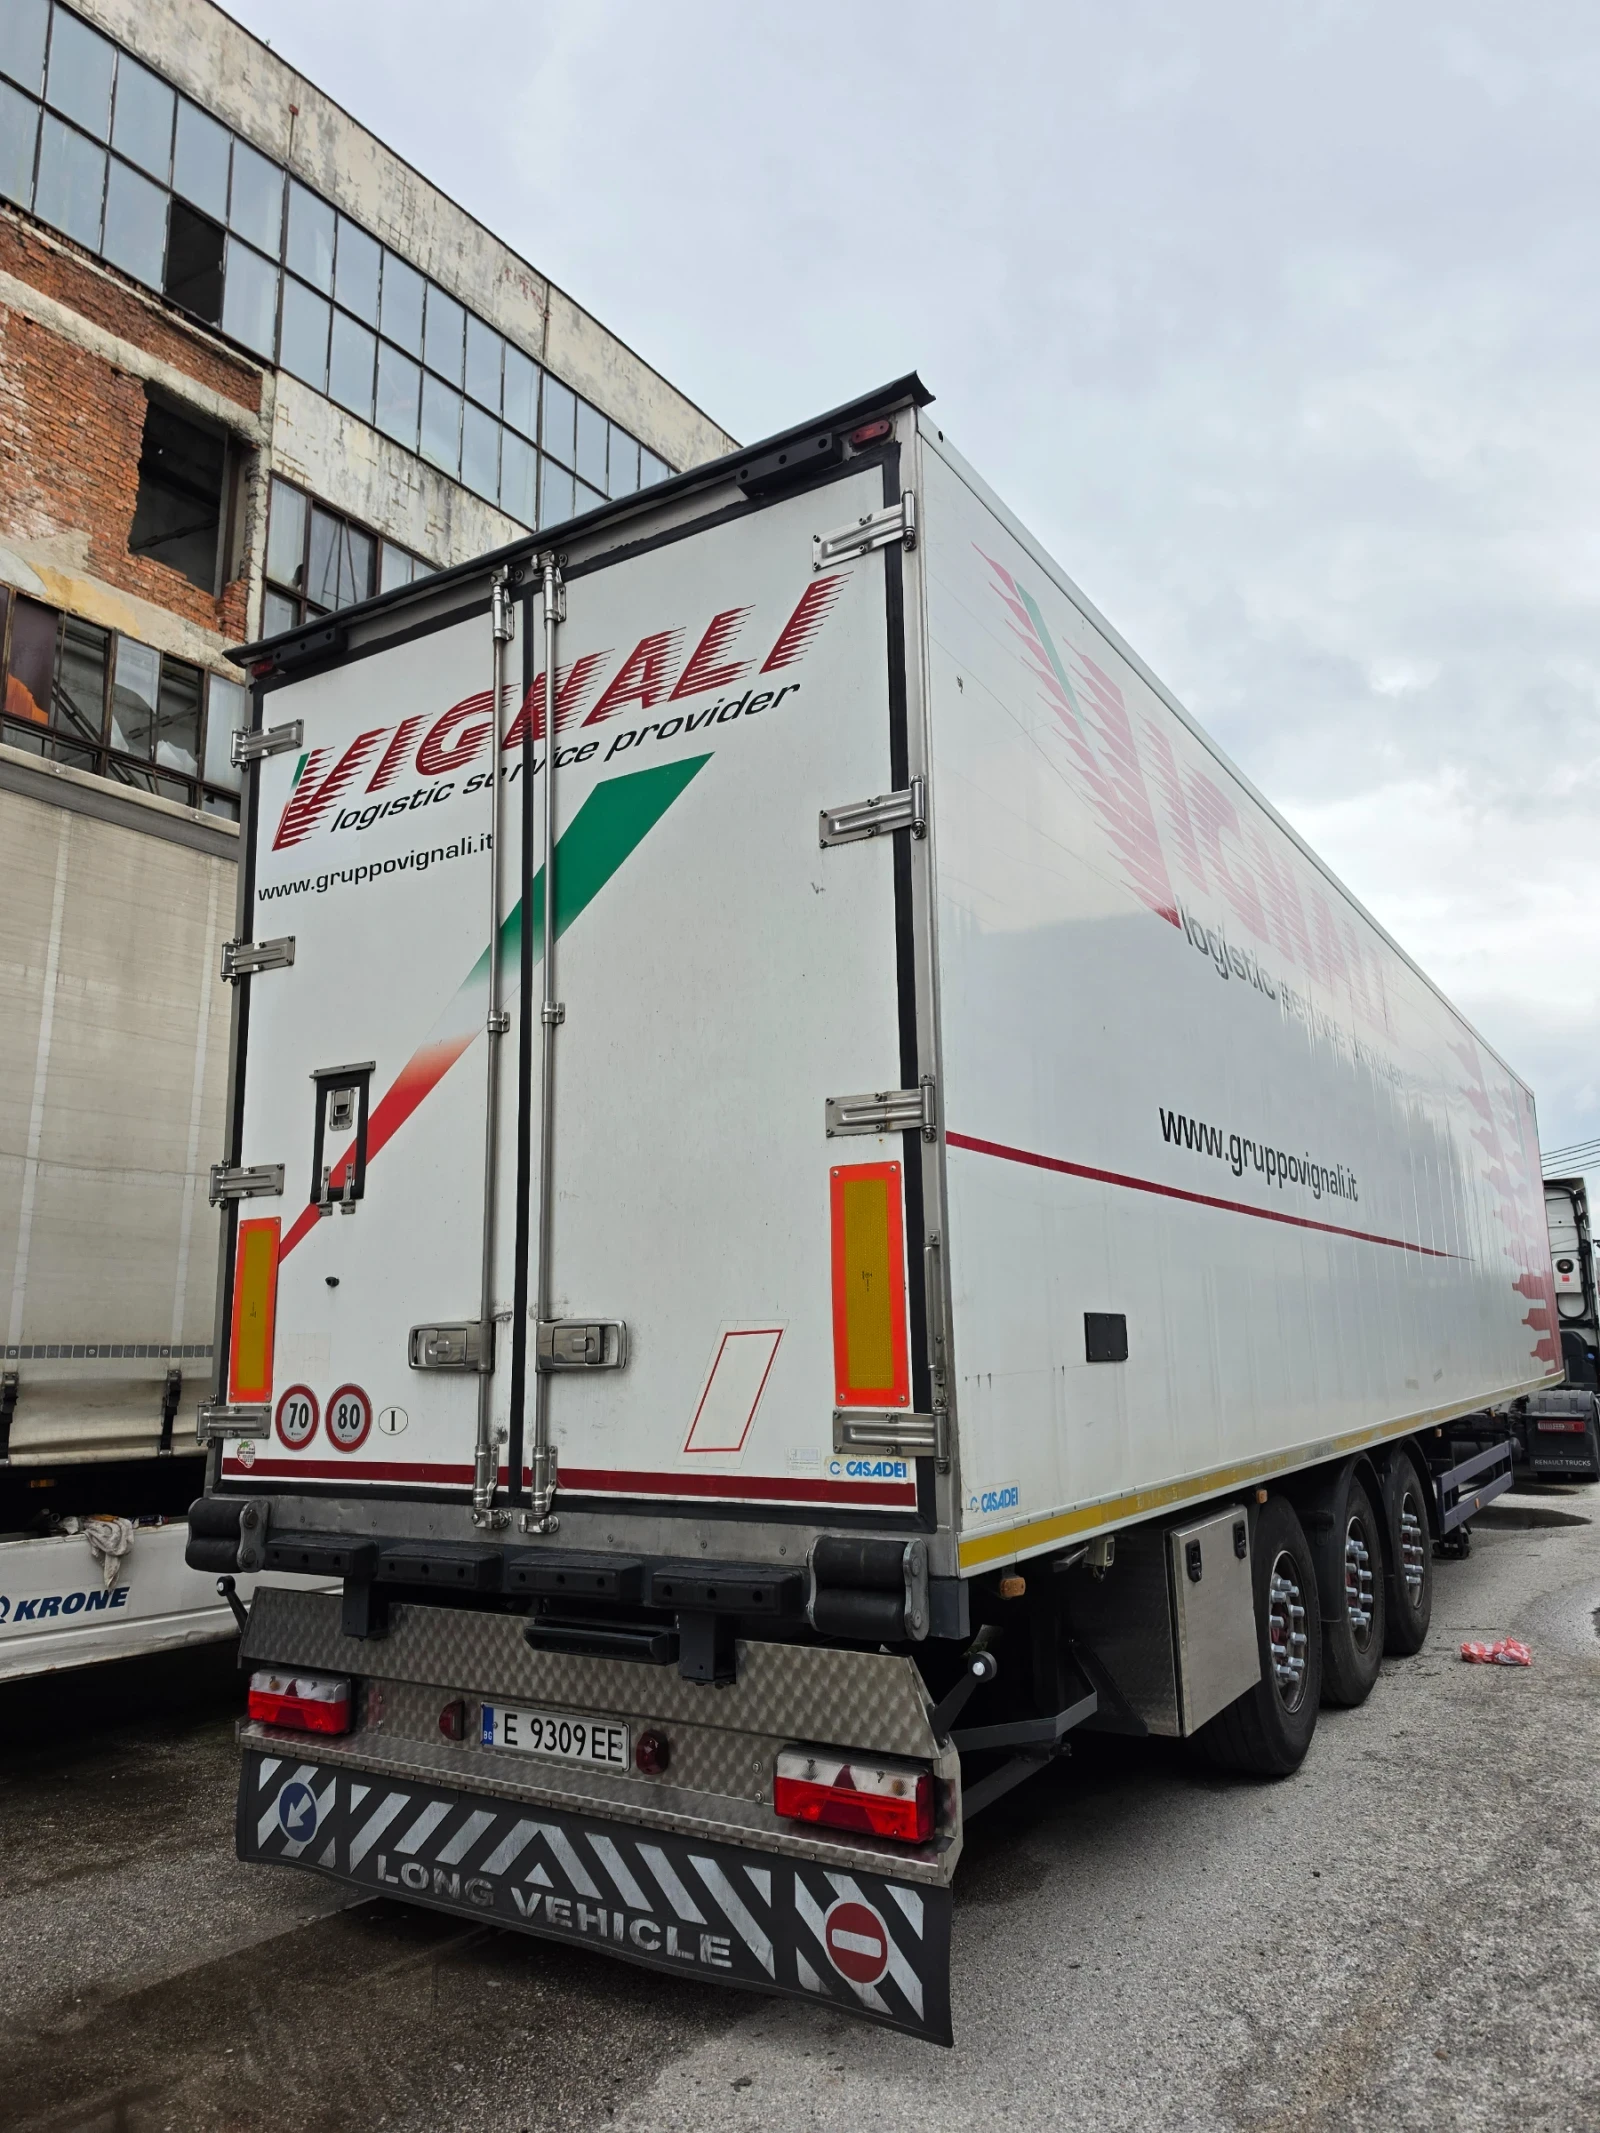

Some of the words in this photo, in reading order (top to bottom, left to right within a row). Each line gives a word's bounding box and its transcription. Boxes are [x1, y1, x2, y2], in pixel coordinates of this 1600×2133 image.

[272, 571, 854, 851] VIGNALI
[330, 781, 455, 832] logistic
[603, 683, 801, 763] provider
[258, 833, 494, 901] www.gruppovignali.it
[1176, 895, 1276, 1001] logistic
[1159, 1107, 1359, 1203] www.gruppovignali.it
[289, 1403, 309, 1429] 70
[338, 1404, 360, 1430] 80
[846, 1461, 907, 1478] CASADEI
[981, 1486, 1019, 1513] CASADEI
[13, 1586, 130, 1622] KRONE
[483, 1730, 493, 1741] BG
[377, 1854, 494, 1907] LONG
[511, 1887, 733, 1968] VEHICLE
